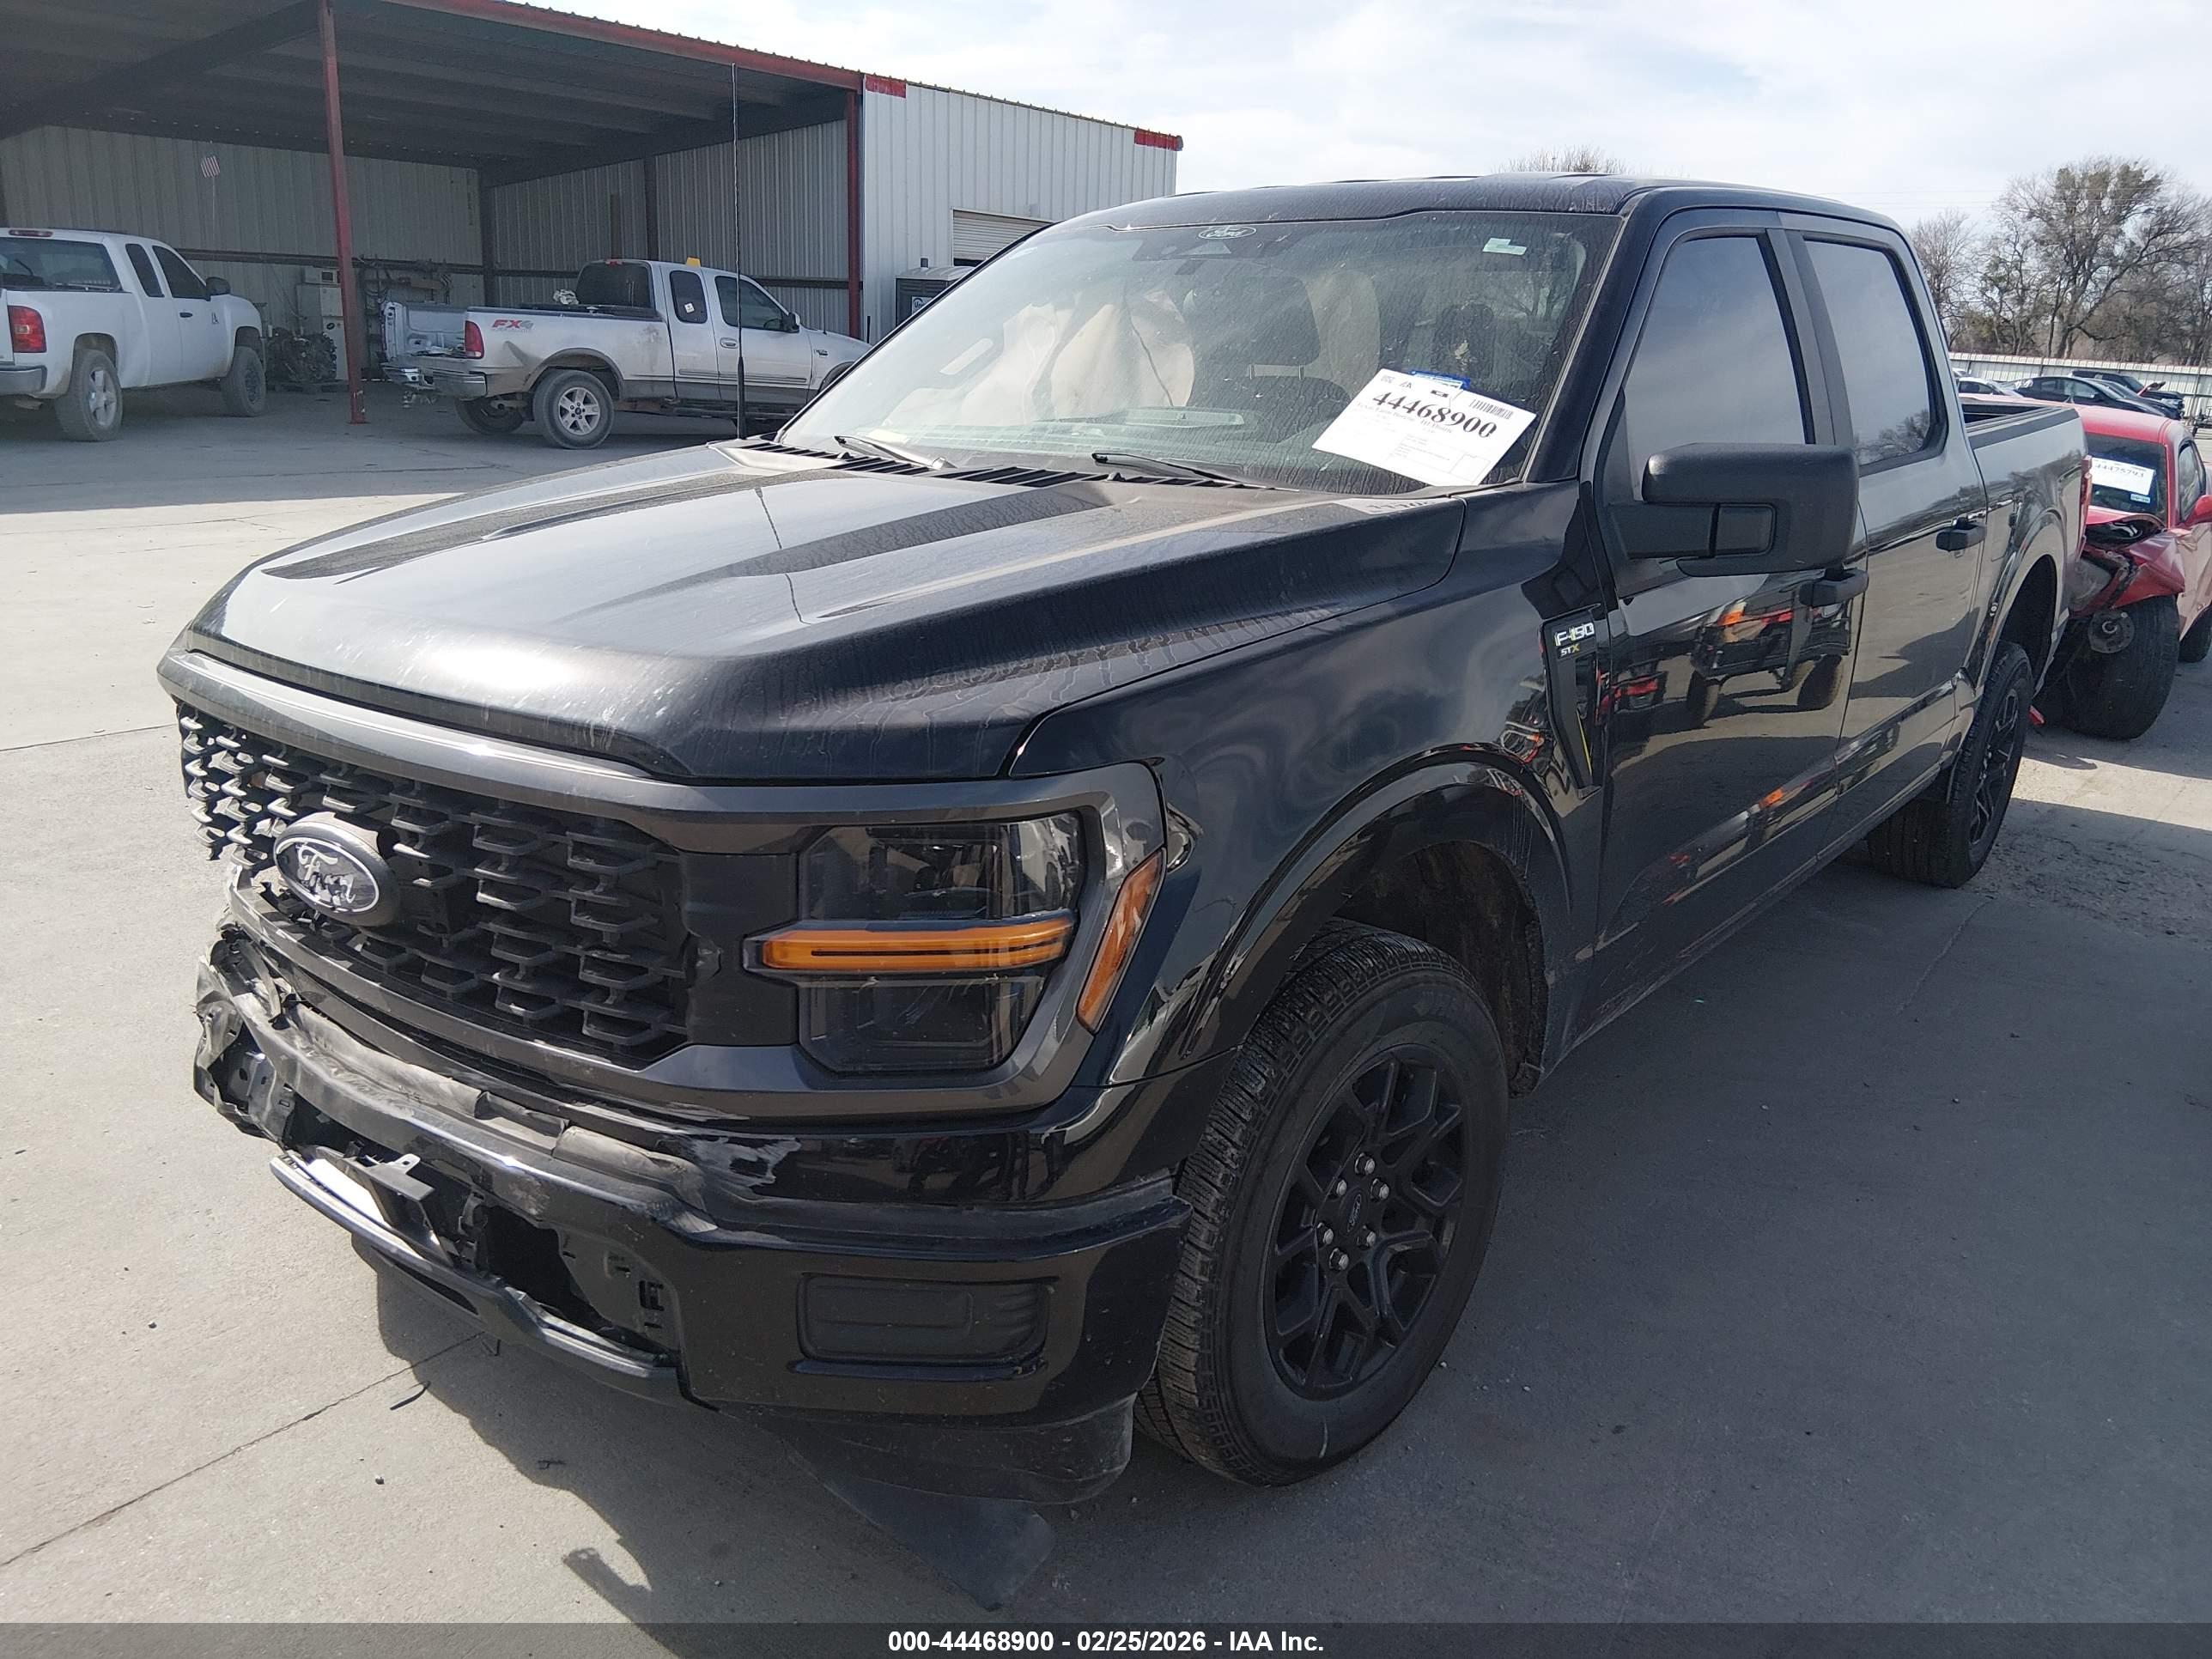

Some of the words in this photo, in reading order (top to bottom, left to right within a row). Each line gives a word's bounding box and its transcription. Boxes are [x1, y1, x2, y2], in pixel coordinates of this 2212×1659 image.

[1206, 226, 1249, 239] Ford
[492, 319, 534, 329] FX4
[1372, 392, 1498, 439] 44468900
[1554, 623, 1595, 646] F-150
[1560, 644, 1580, 658] STX
